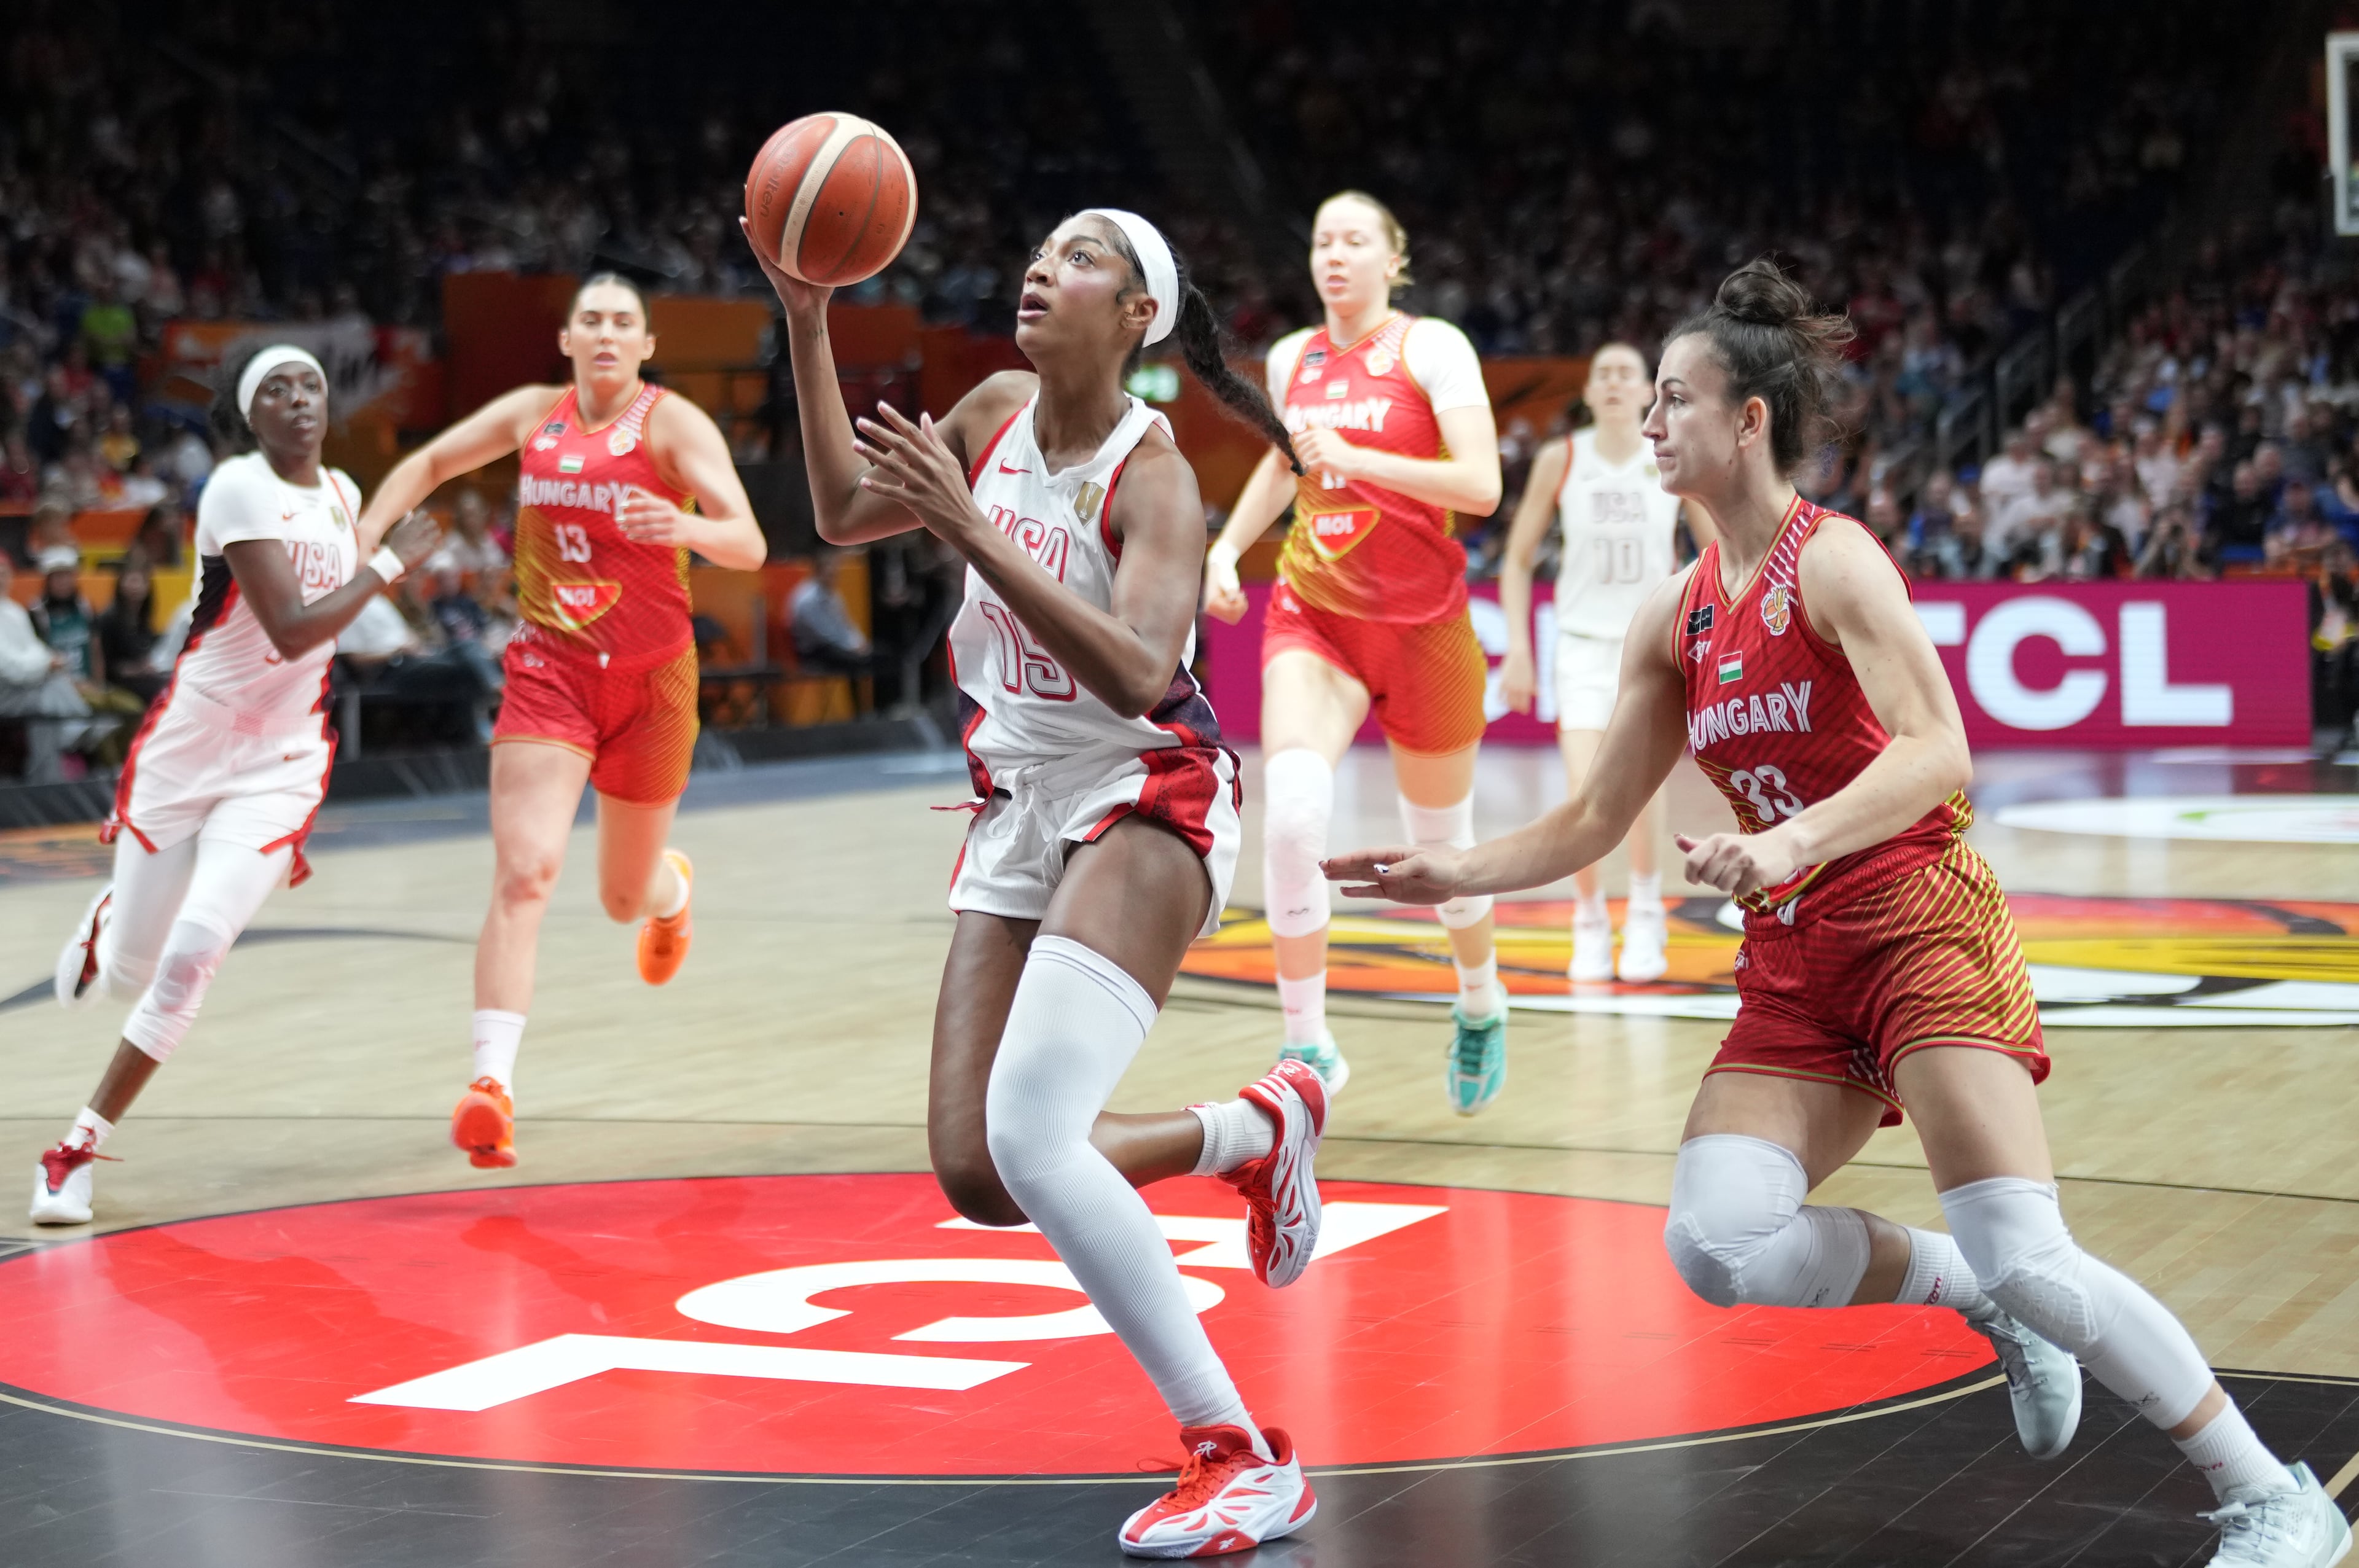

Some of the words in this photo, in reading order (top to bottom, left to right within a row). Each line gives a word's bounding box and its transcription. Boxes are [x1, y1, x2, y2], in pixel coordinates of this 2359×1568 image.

[521, 474, 630, 521] HUNGARY
[555, 524, 592, 563] 13
[1594, 538, 1643, 584] 10
[980, 601, 1077, 702] 15
[1912, 596, 2234, 730] CL
[1687, 681, 1812, 756] HUNGARY
[1730, 765, 1804, 822] 33
